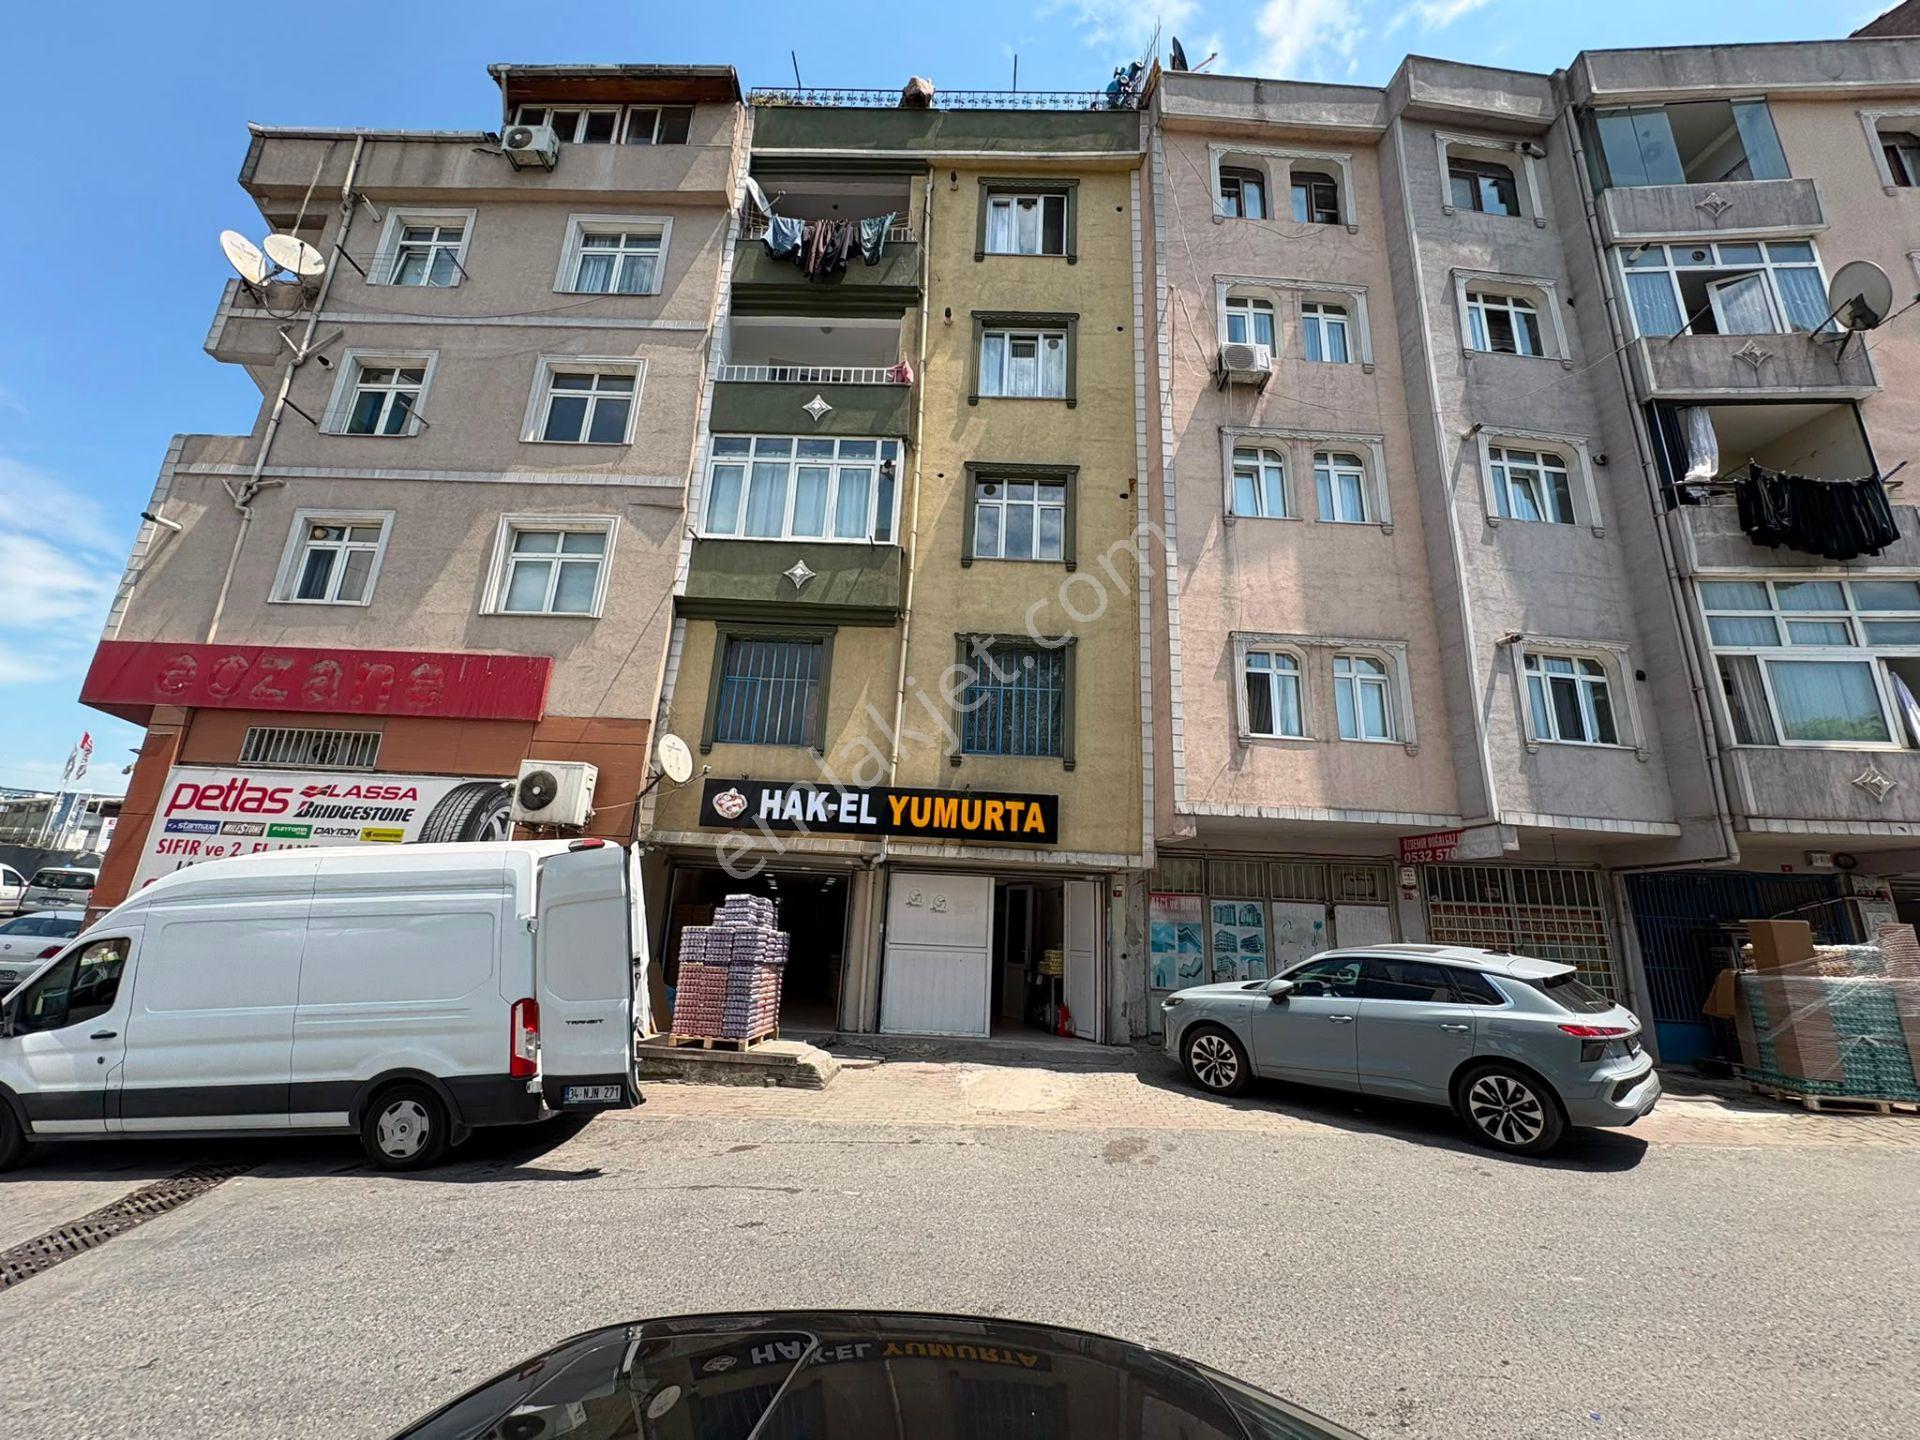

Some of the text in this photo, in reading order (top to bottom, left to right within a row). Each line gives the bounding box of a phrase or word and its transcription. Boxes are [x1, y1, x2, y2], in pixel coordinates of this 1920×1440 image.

[164, 777, 293, 817] petlas
[329, 784, 418, 801] LASSA
[293, 801, 415, 822] BRIDGESTONE
[759, 788, 1046, 833] HAK-EL YUMURTA
[313, 827, 361, 836] DAYTON
[156, 838, 202, 855] SIFIR
[205, 845, 225, 857] ve
[1404, 850, 1432, 864] 0532
[1435, 847, 1458, 861] 570
[569, 1086, 619, 1100] 34 NJN 271
